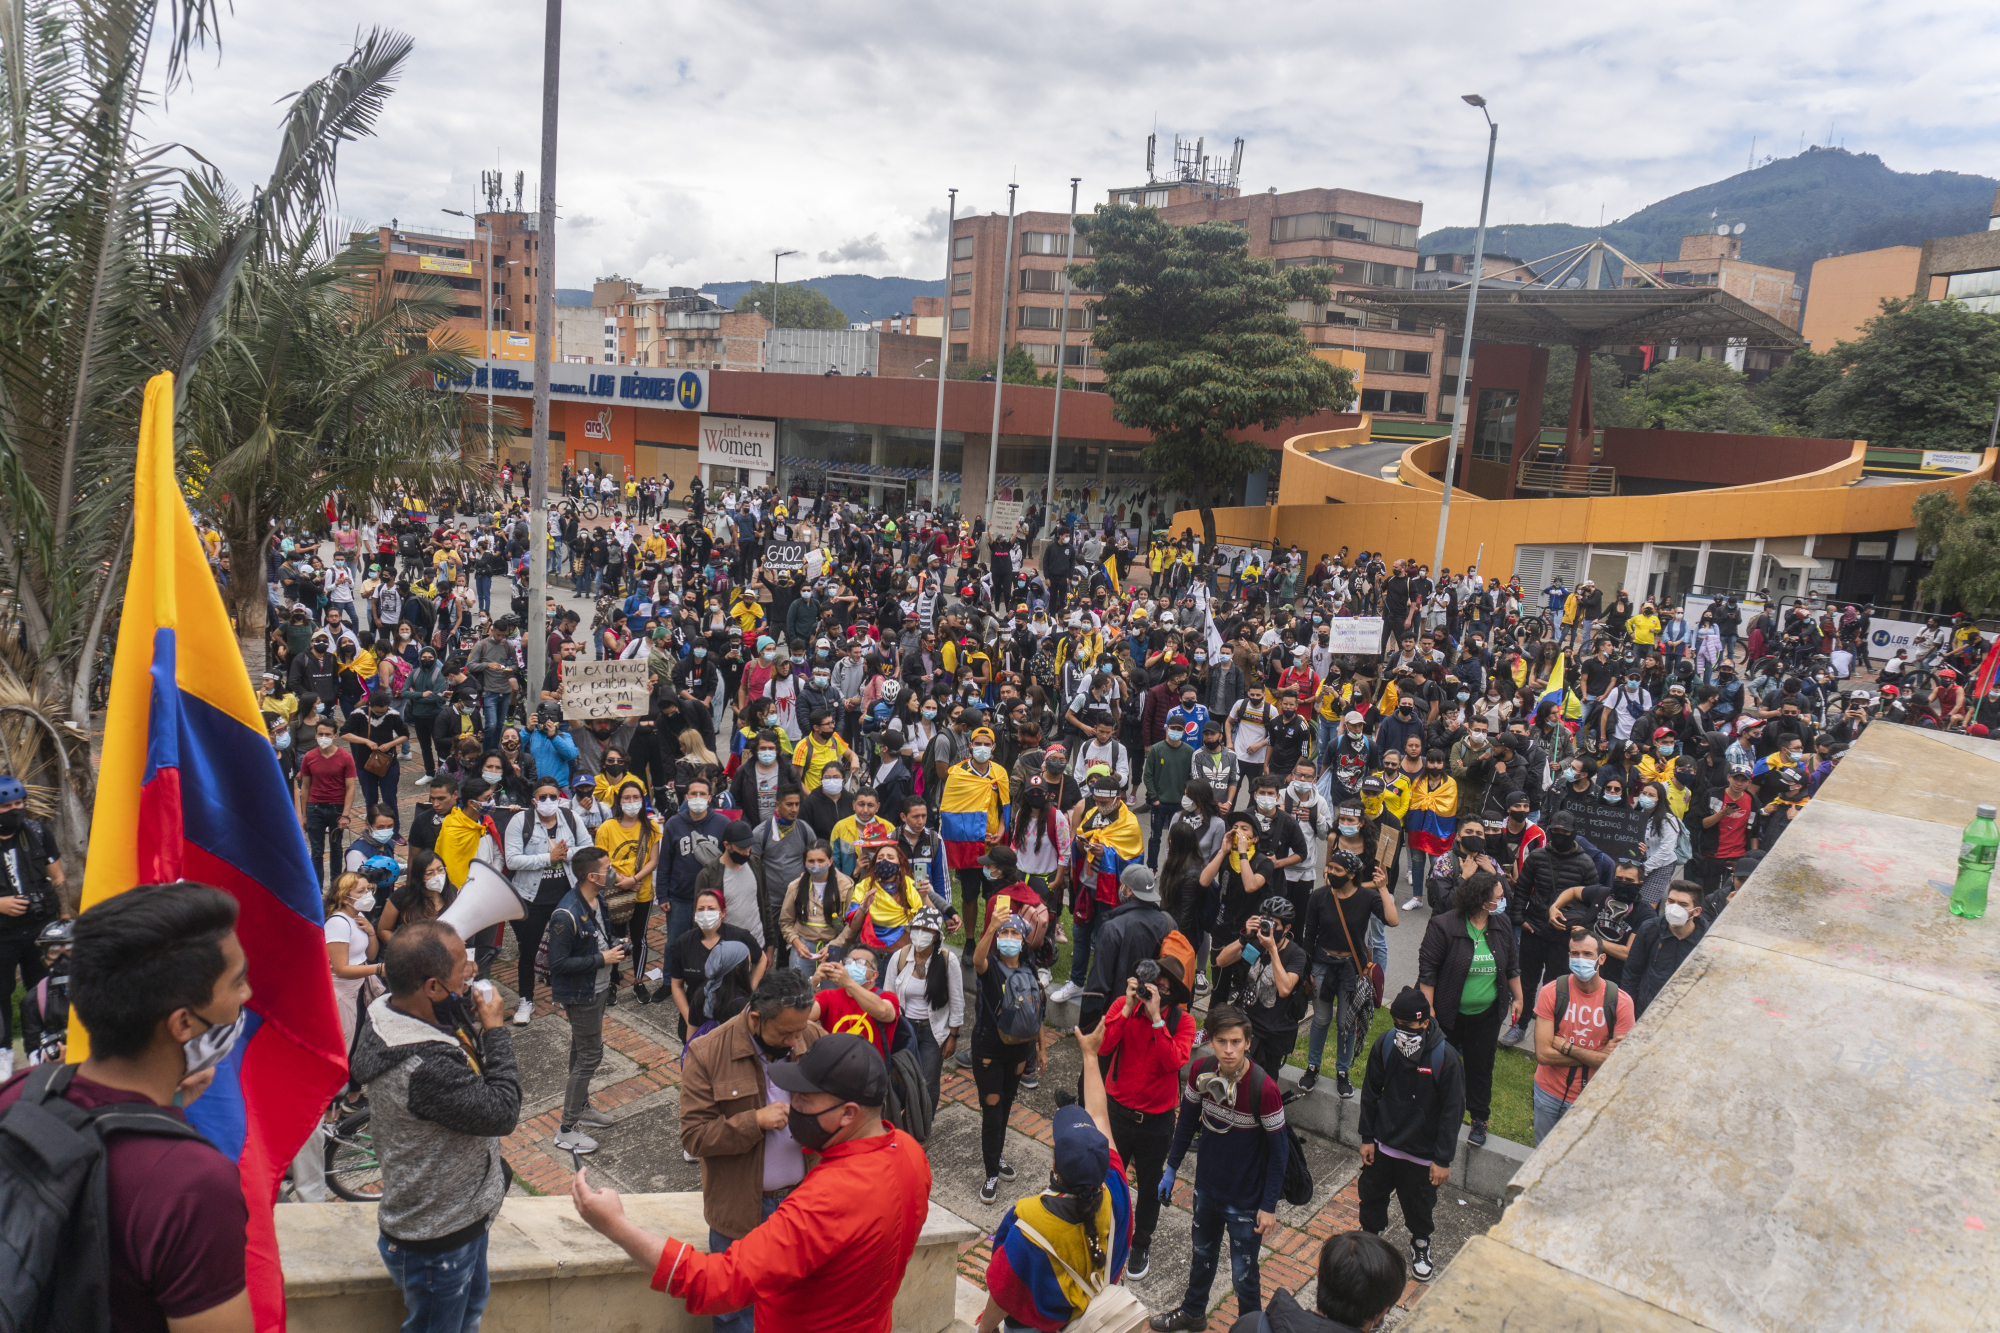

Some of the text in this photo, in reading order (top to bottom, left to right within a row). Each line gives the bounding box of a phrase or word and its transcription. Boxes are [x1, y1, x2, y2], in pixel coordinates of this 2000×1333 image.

[588, 374, 615, 397] LOS
[620, 370, 676, 400] HÉROES
[585, 421, 602, 434] ara
[723, 422, 741, 438] Inti
[703, 428, 762, 458] Women
[766, 545, 802, 562] 6402
[1891, 635, 1909, 644] LOS
[584, 665, 601, 676] ex
[566, 681, 585, 693] Ser
[567, 698, 591, 708] eso
[596, 693, 612, 704] es
[589, 705, 612, 717] ex
[1566, 800, 1585, 812] COMO
[1587, 806, 1595, 814] EL
[1596, 807, 1626, 819] GOBIERNO
[1628, 825, 1639, 833] SUS
[680, 835, 718, 856] GP
[1564, 1002, 1606, 1027] HCO
